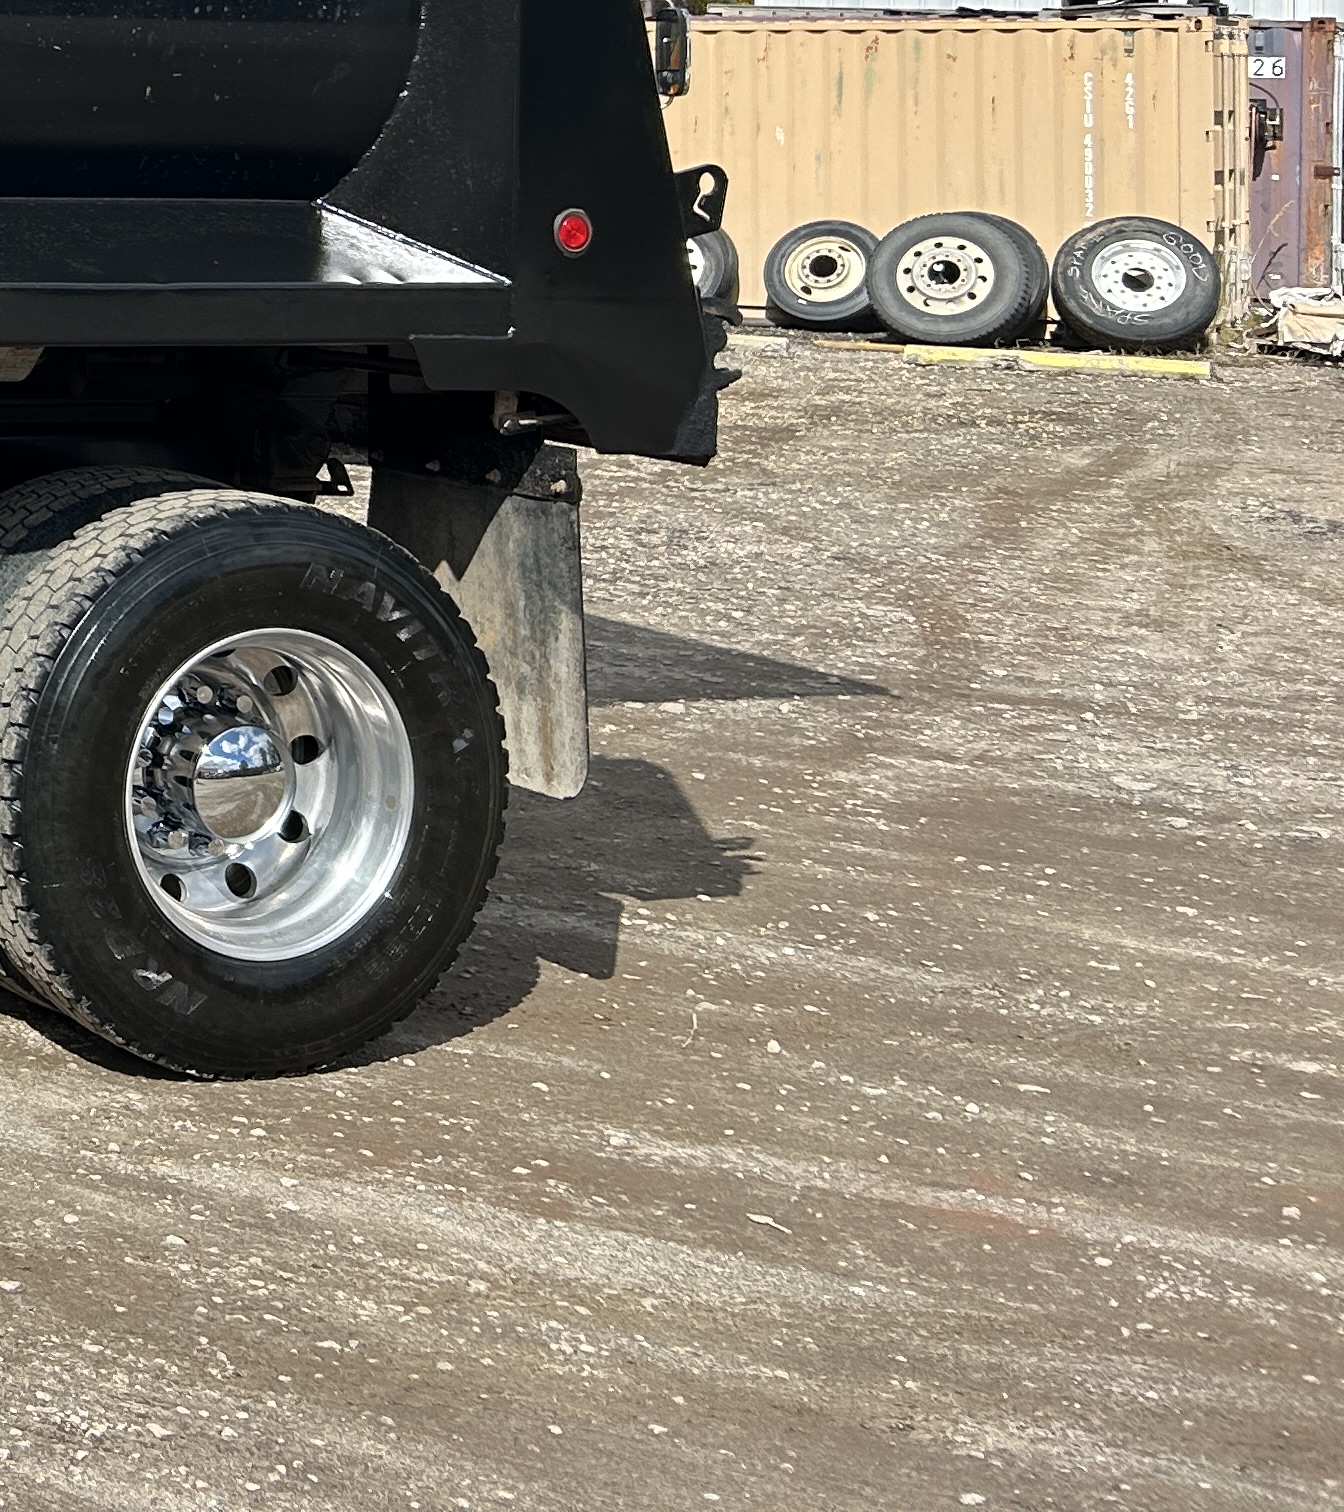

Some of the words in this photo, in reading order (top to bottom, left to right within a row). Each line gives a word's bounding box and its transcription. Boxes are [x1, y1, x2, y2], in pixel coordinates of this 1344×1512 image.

[1083, 71, 1094, 128] CSIU
[1124, 72, 1135, 129] 42G1
[1163, 231, 1210, 282] GOOD
